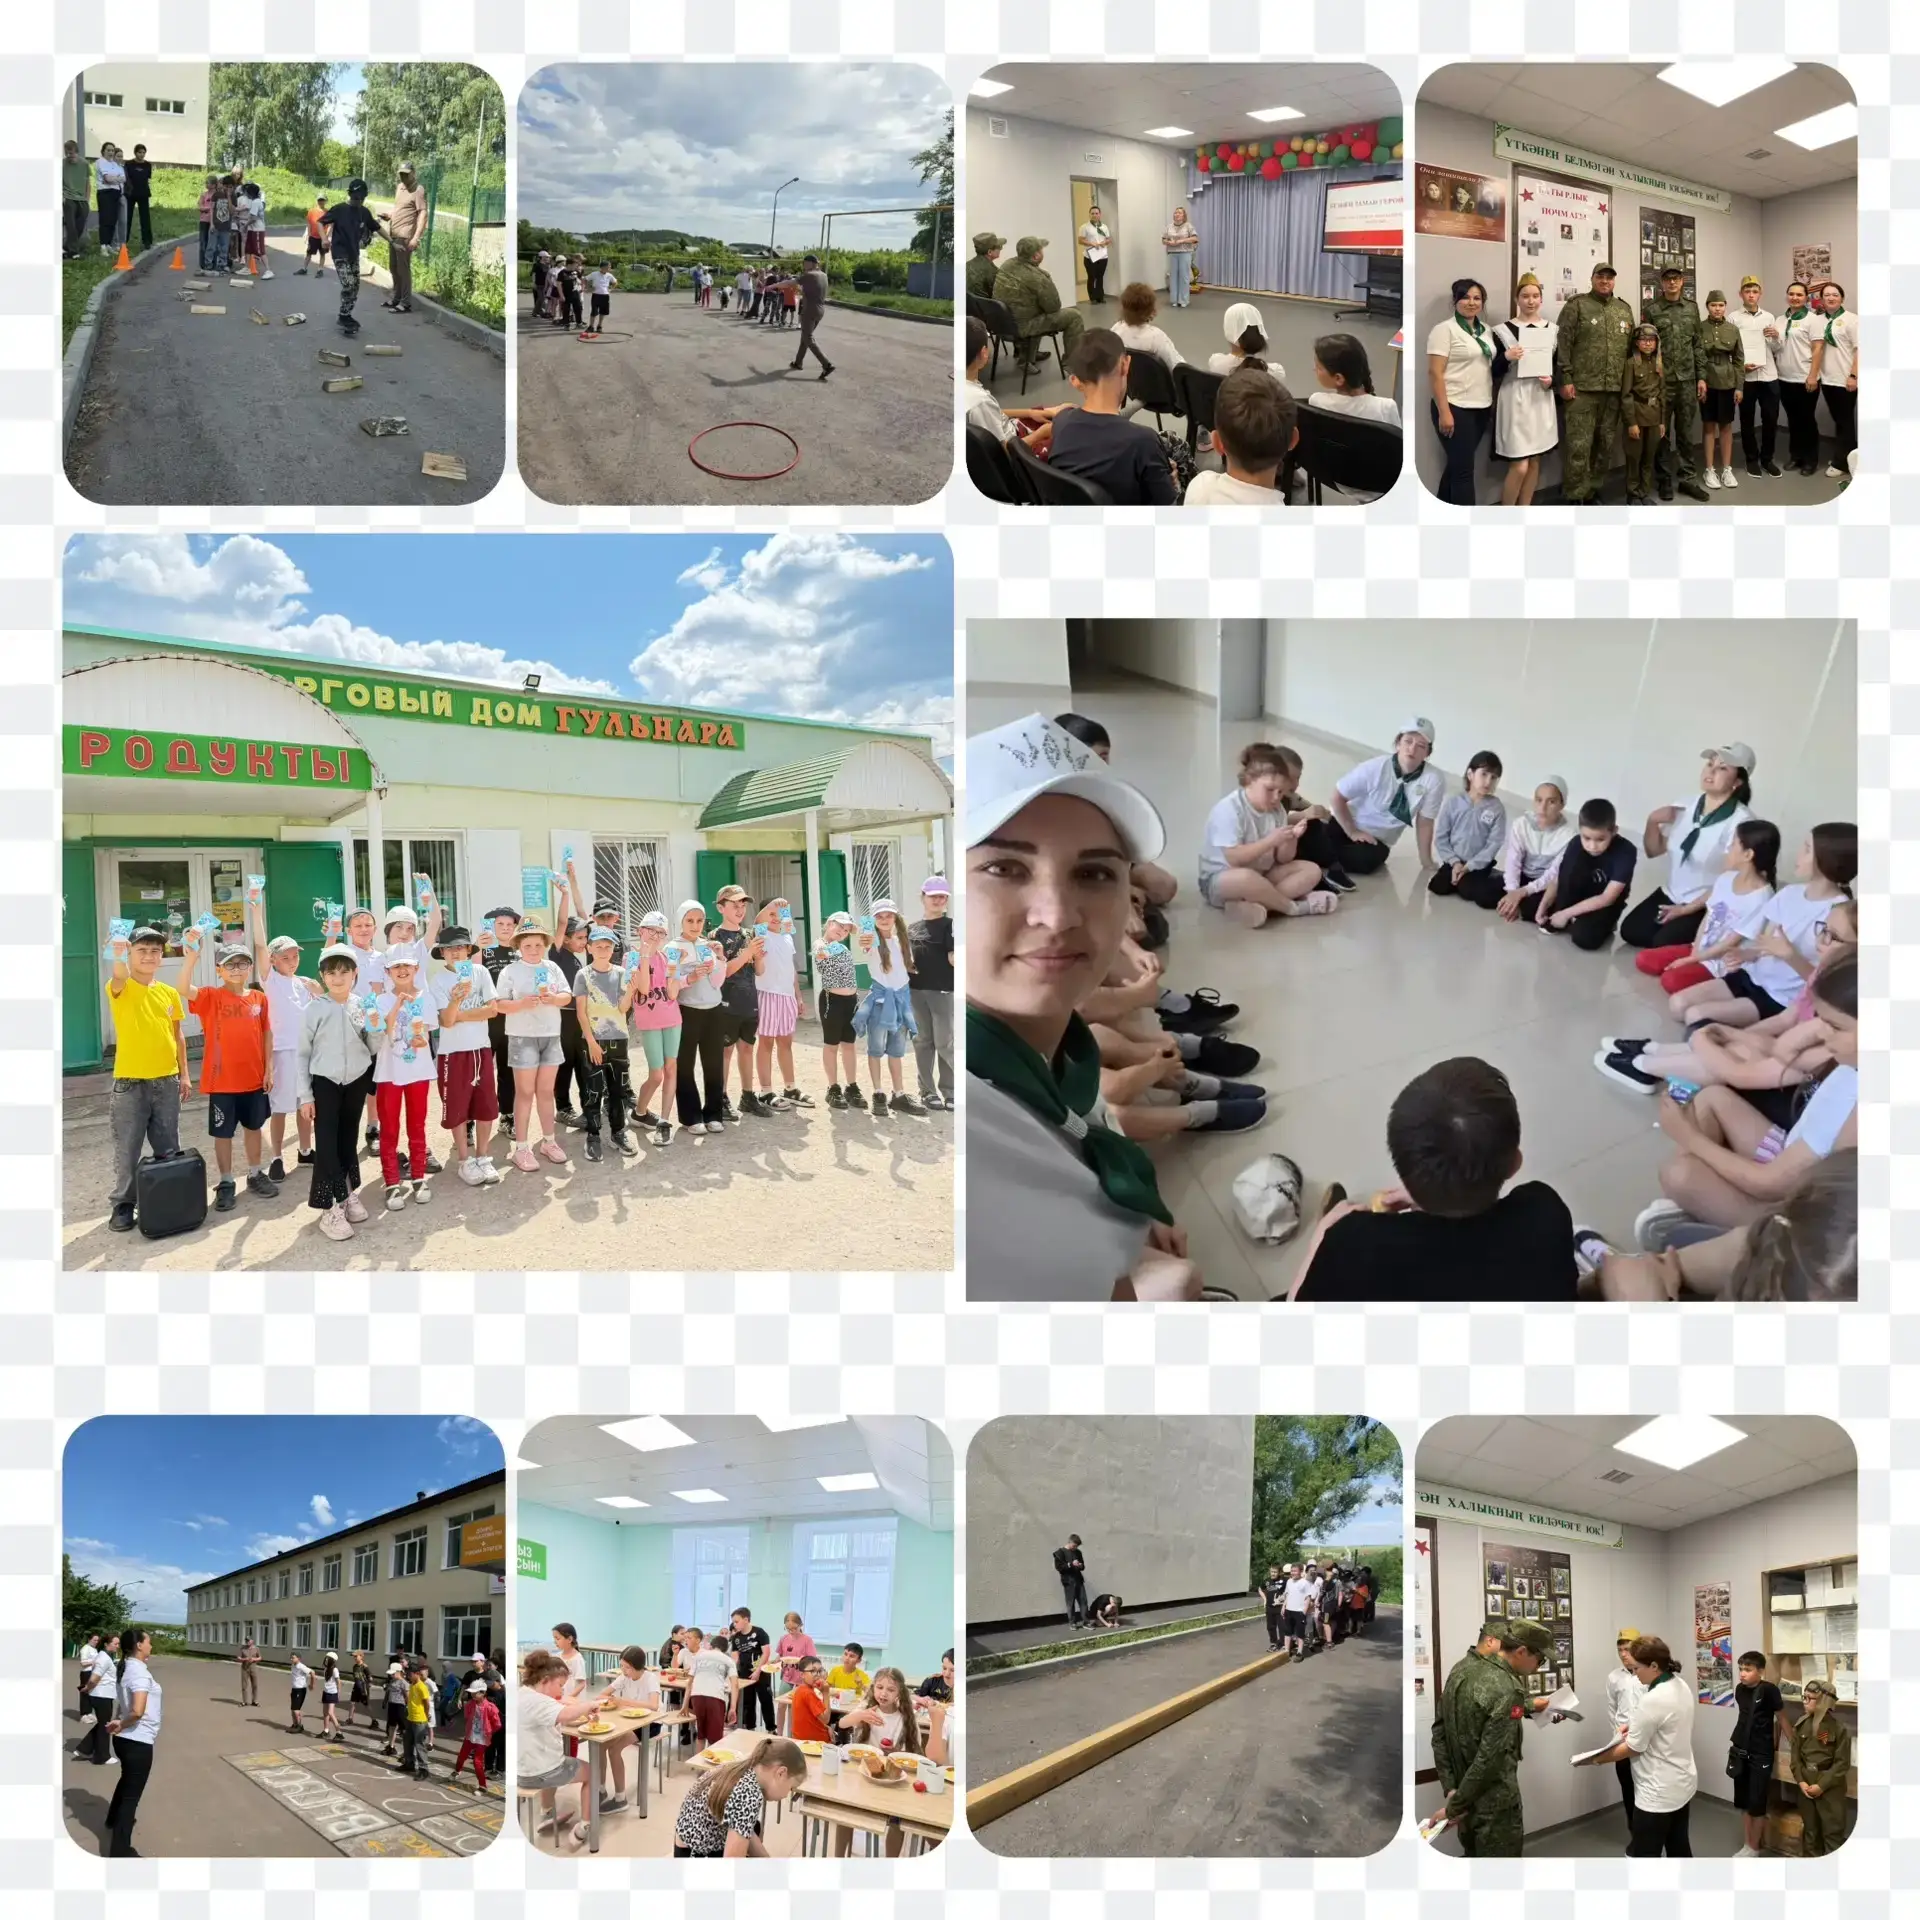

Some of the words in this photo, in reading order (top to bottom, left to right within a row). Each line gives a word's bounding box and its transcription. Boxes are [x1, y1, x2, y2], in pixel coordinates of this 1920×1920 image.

[470, 697, 542, 727] ДОМ
[555, 706, 738, 747] ГУЛЬНАРА
[80, 730, 350, 783] РОДУКТЫ
[1529, 1513, 1581, 1533] КИЛӘЧӘГЕ
[1586, 1524, 1605, 1536] ЮК!
[248, 1764, 388, 1838] ВЫПУСК
